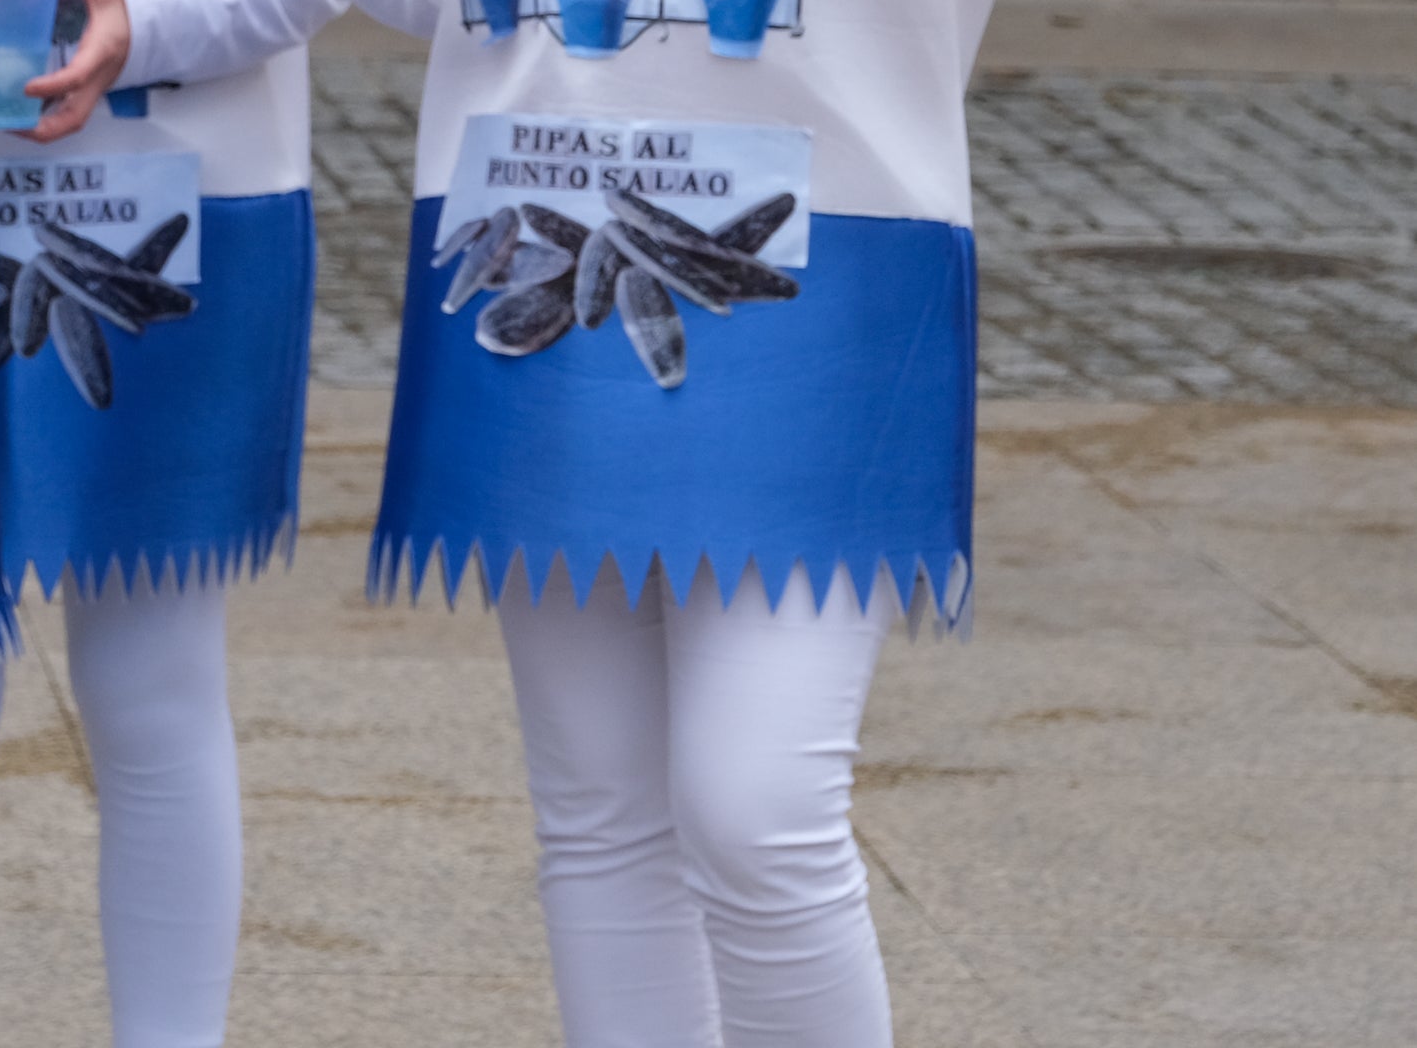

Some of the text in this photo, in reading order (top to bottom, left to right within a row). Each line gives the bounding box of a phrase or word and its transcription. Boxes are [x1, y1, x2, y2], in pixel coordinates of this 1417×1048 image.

[511, 125, 688, 159] PIPAS AL
[58, 165, 103, 193] AL
[487, 159, 730, 197] PUNTO SALAO
[28, 201, 139, 228] SALAO
